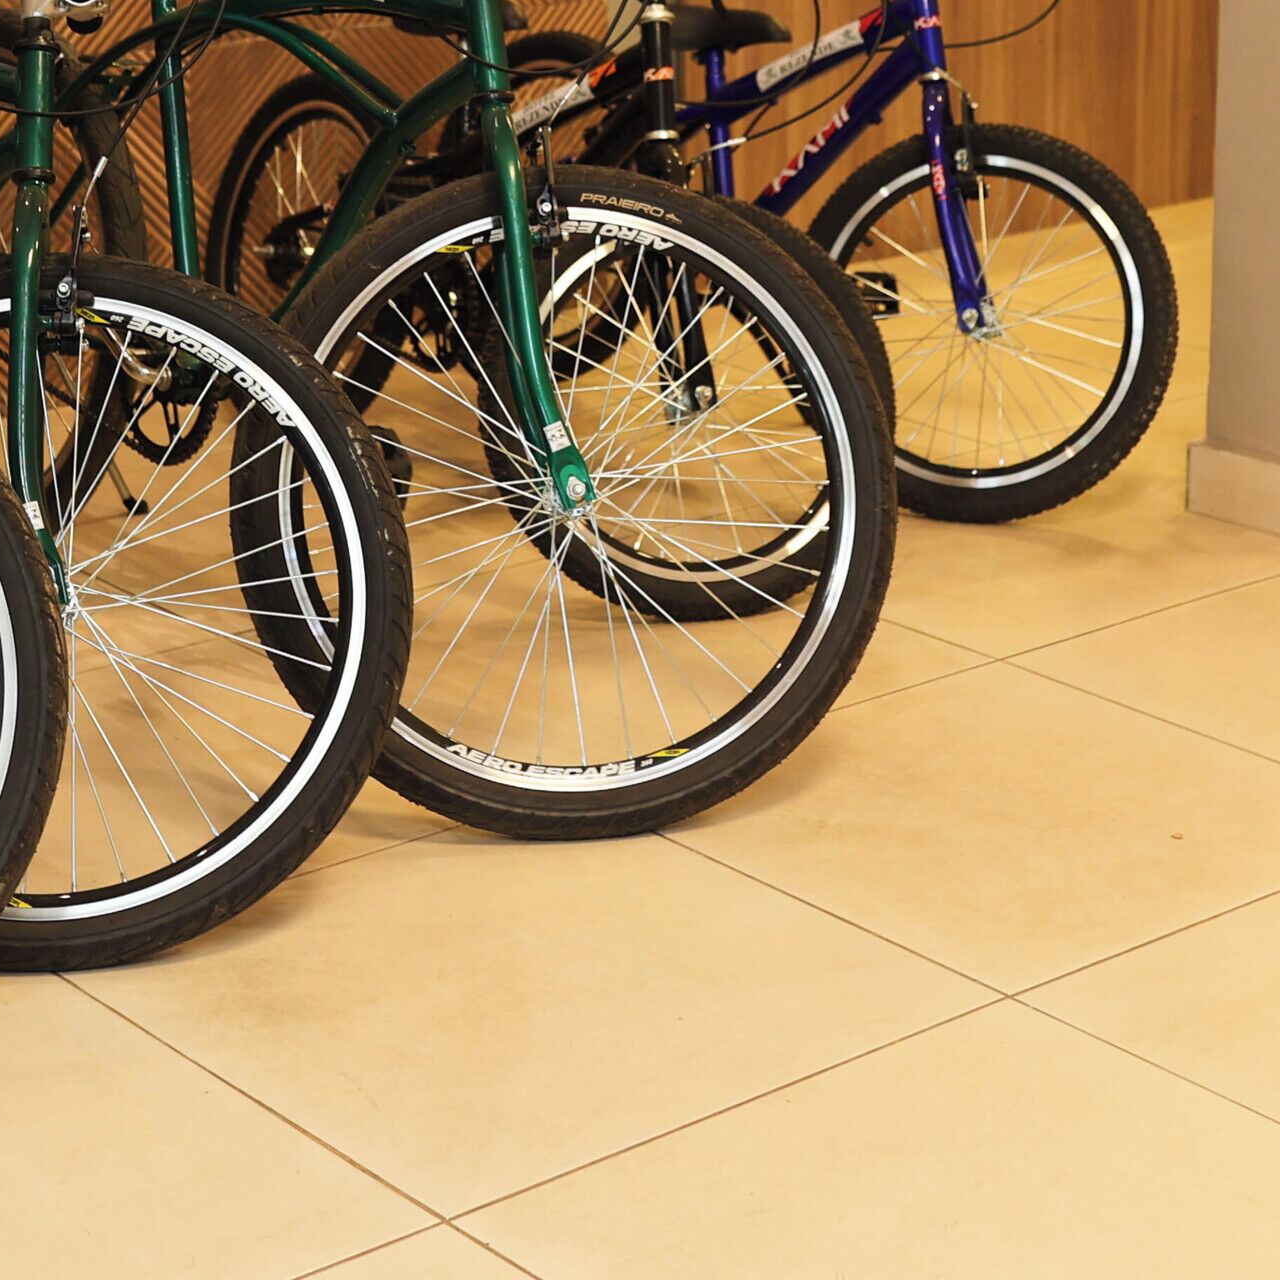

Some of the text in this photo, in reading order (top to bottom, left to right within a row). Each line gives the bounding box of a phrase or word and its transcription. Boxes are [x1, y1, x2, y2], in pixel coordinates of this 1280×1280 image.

[579, 192, 666, 219] PRAIEIRO
[598, 223, 675, 252] AERO
[127, 317, 243, 376] ESCAPE
[233, 370, 297, 428] AERO
[446, 742, 526, 775] AERO
[527, 760, 636, 779] ESCAPE
